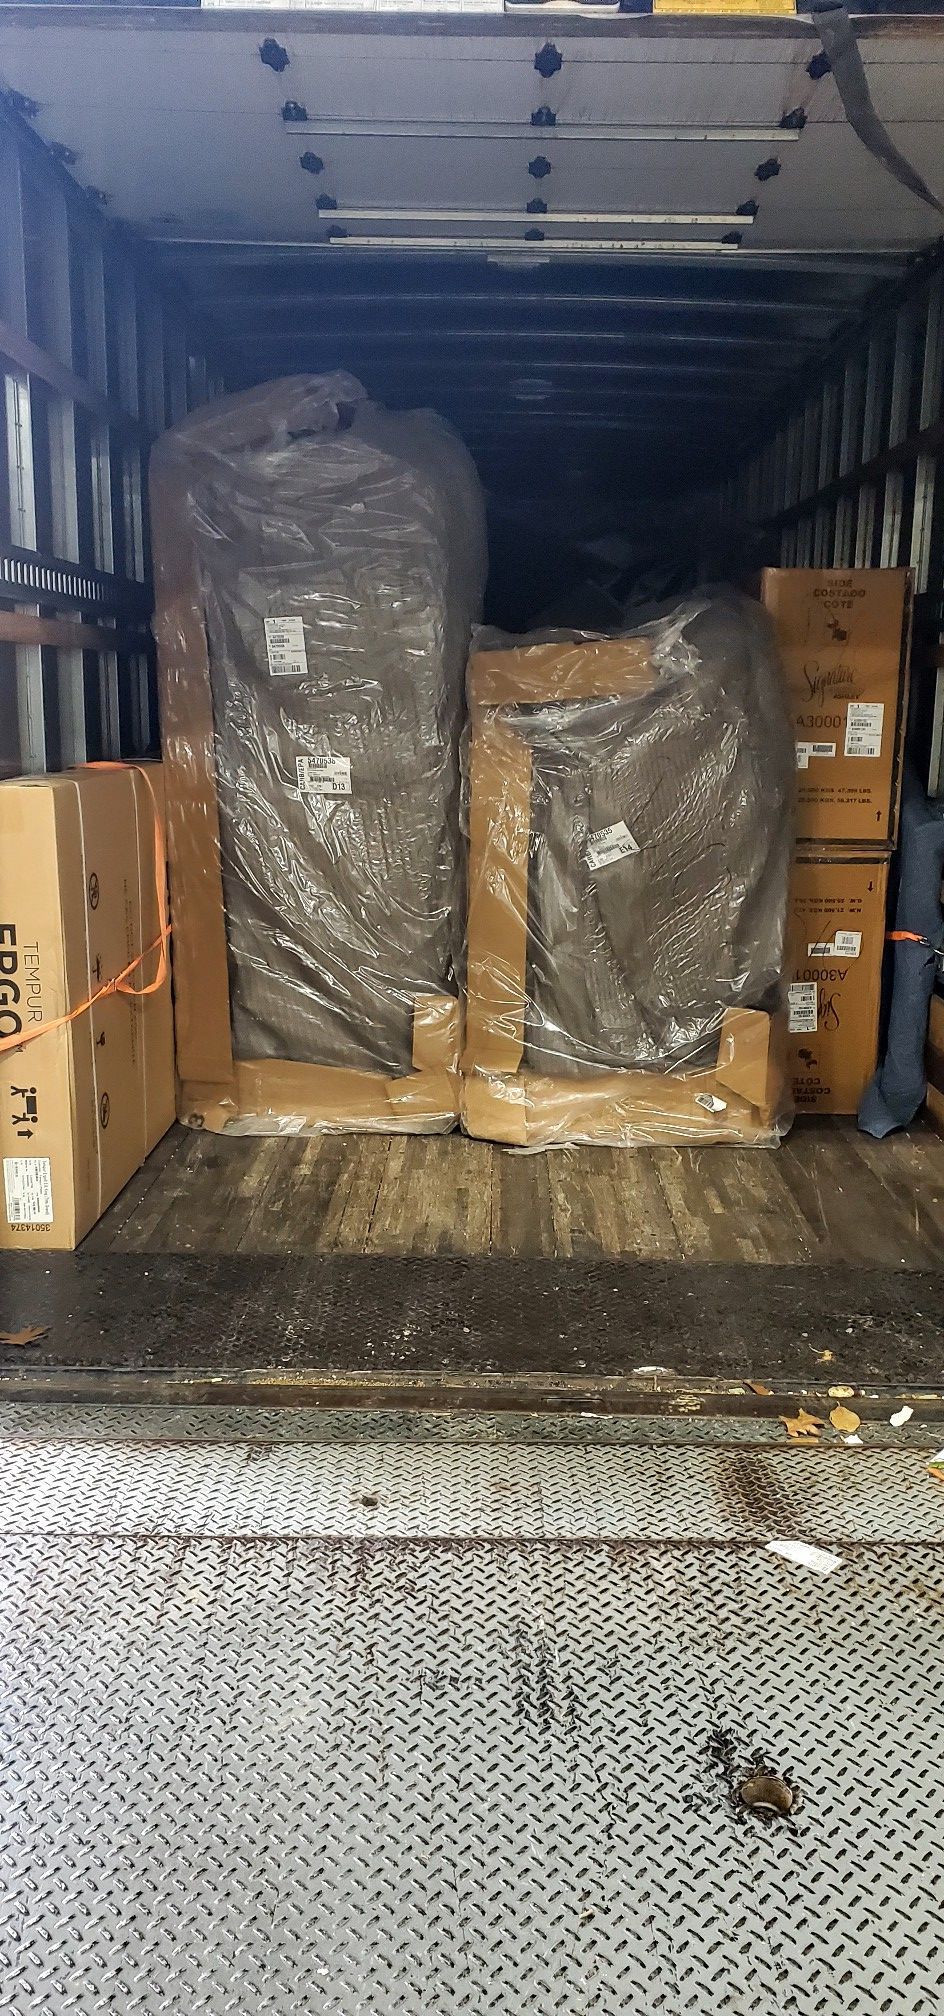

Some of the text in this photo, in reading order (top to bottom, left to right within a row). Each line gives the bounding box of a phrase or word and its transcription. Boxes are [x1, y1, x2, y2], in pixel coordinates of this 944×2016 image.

[814, 588, 866, 598] COSTADO
[332, 782, 346, 791] D13
[795, 968, 849, 981] A30001
[23, 941, 43, 1023] TEMPUR
[11, 1223, 51, 1232] 35014374
